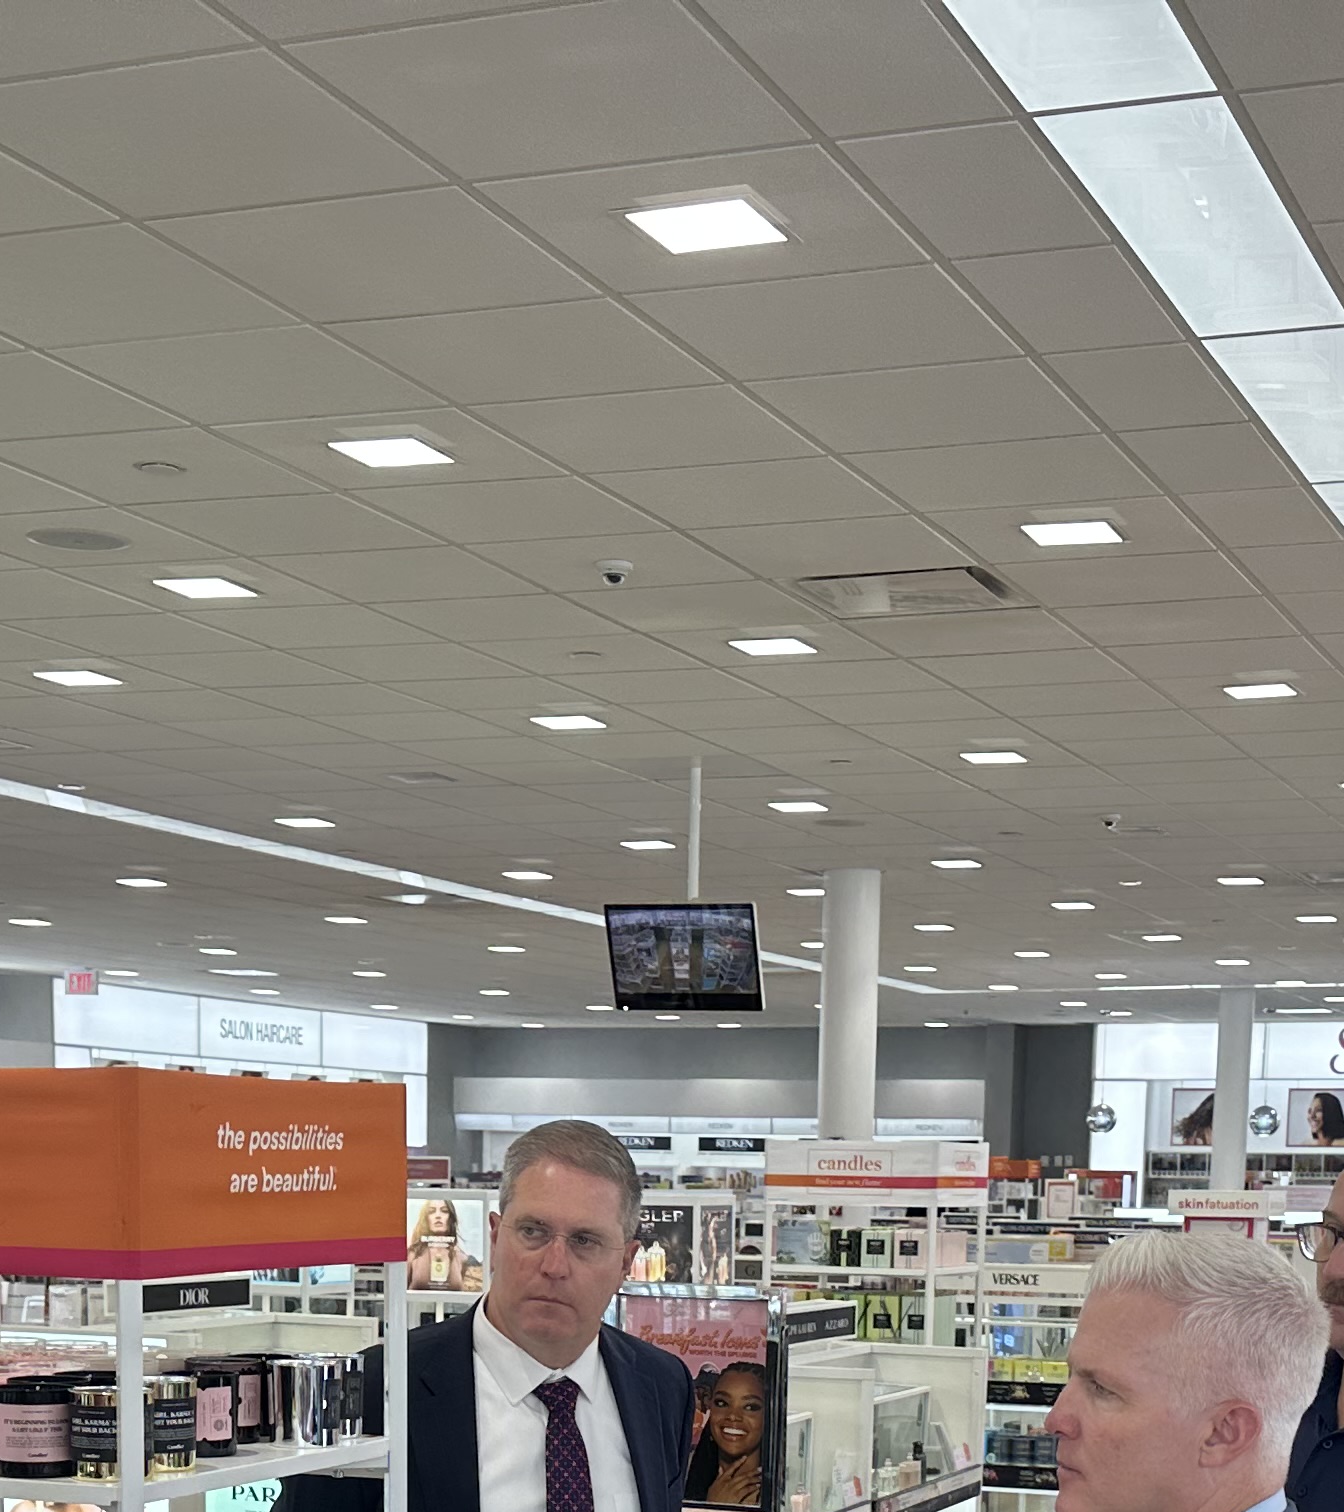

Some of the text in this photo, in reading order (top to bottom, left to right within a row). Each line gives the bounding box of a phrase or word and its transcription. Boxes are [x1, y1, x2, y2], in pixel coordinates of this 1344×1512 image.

[219, 1018, 304, 1045] SALON HAIRCARE
[217, 1123, 344, 1154] the possibilities
[618, 1137, 655, 1146] REDKEN
[715, 1138, 754, 1148] REDKEN
[817, 1155, 882, 1172] candles
[230, 1165, 338, 1193] are beautiful.
[1178, 1198, 1260, 1210] skinfatuation
[640, 1210, 685, 1223] GLER
[992, 1273, 1040, 1286] VERSACE
[180, 1288, 210, 1306] DIOR
[824, 1317, 849, 1330] AZZARO
